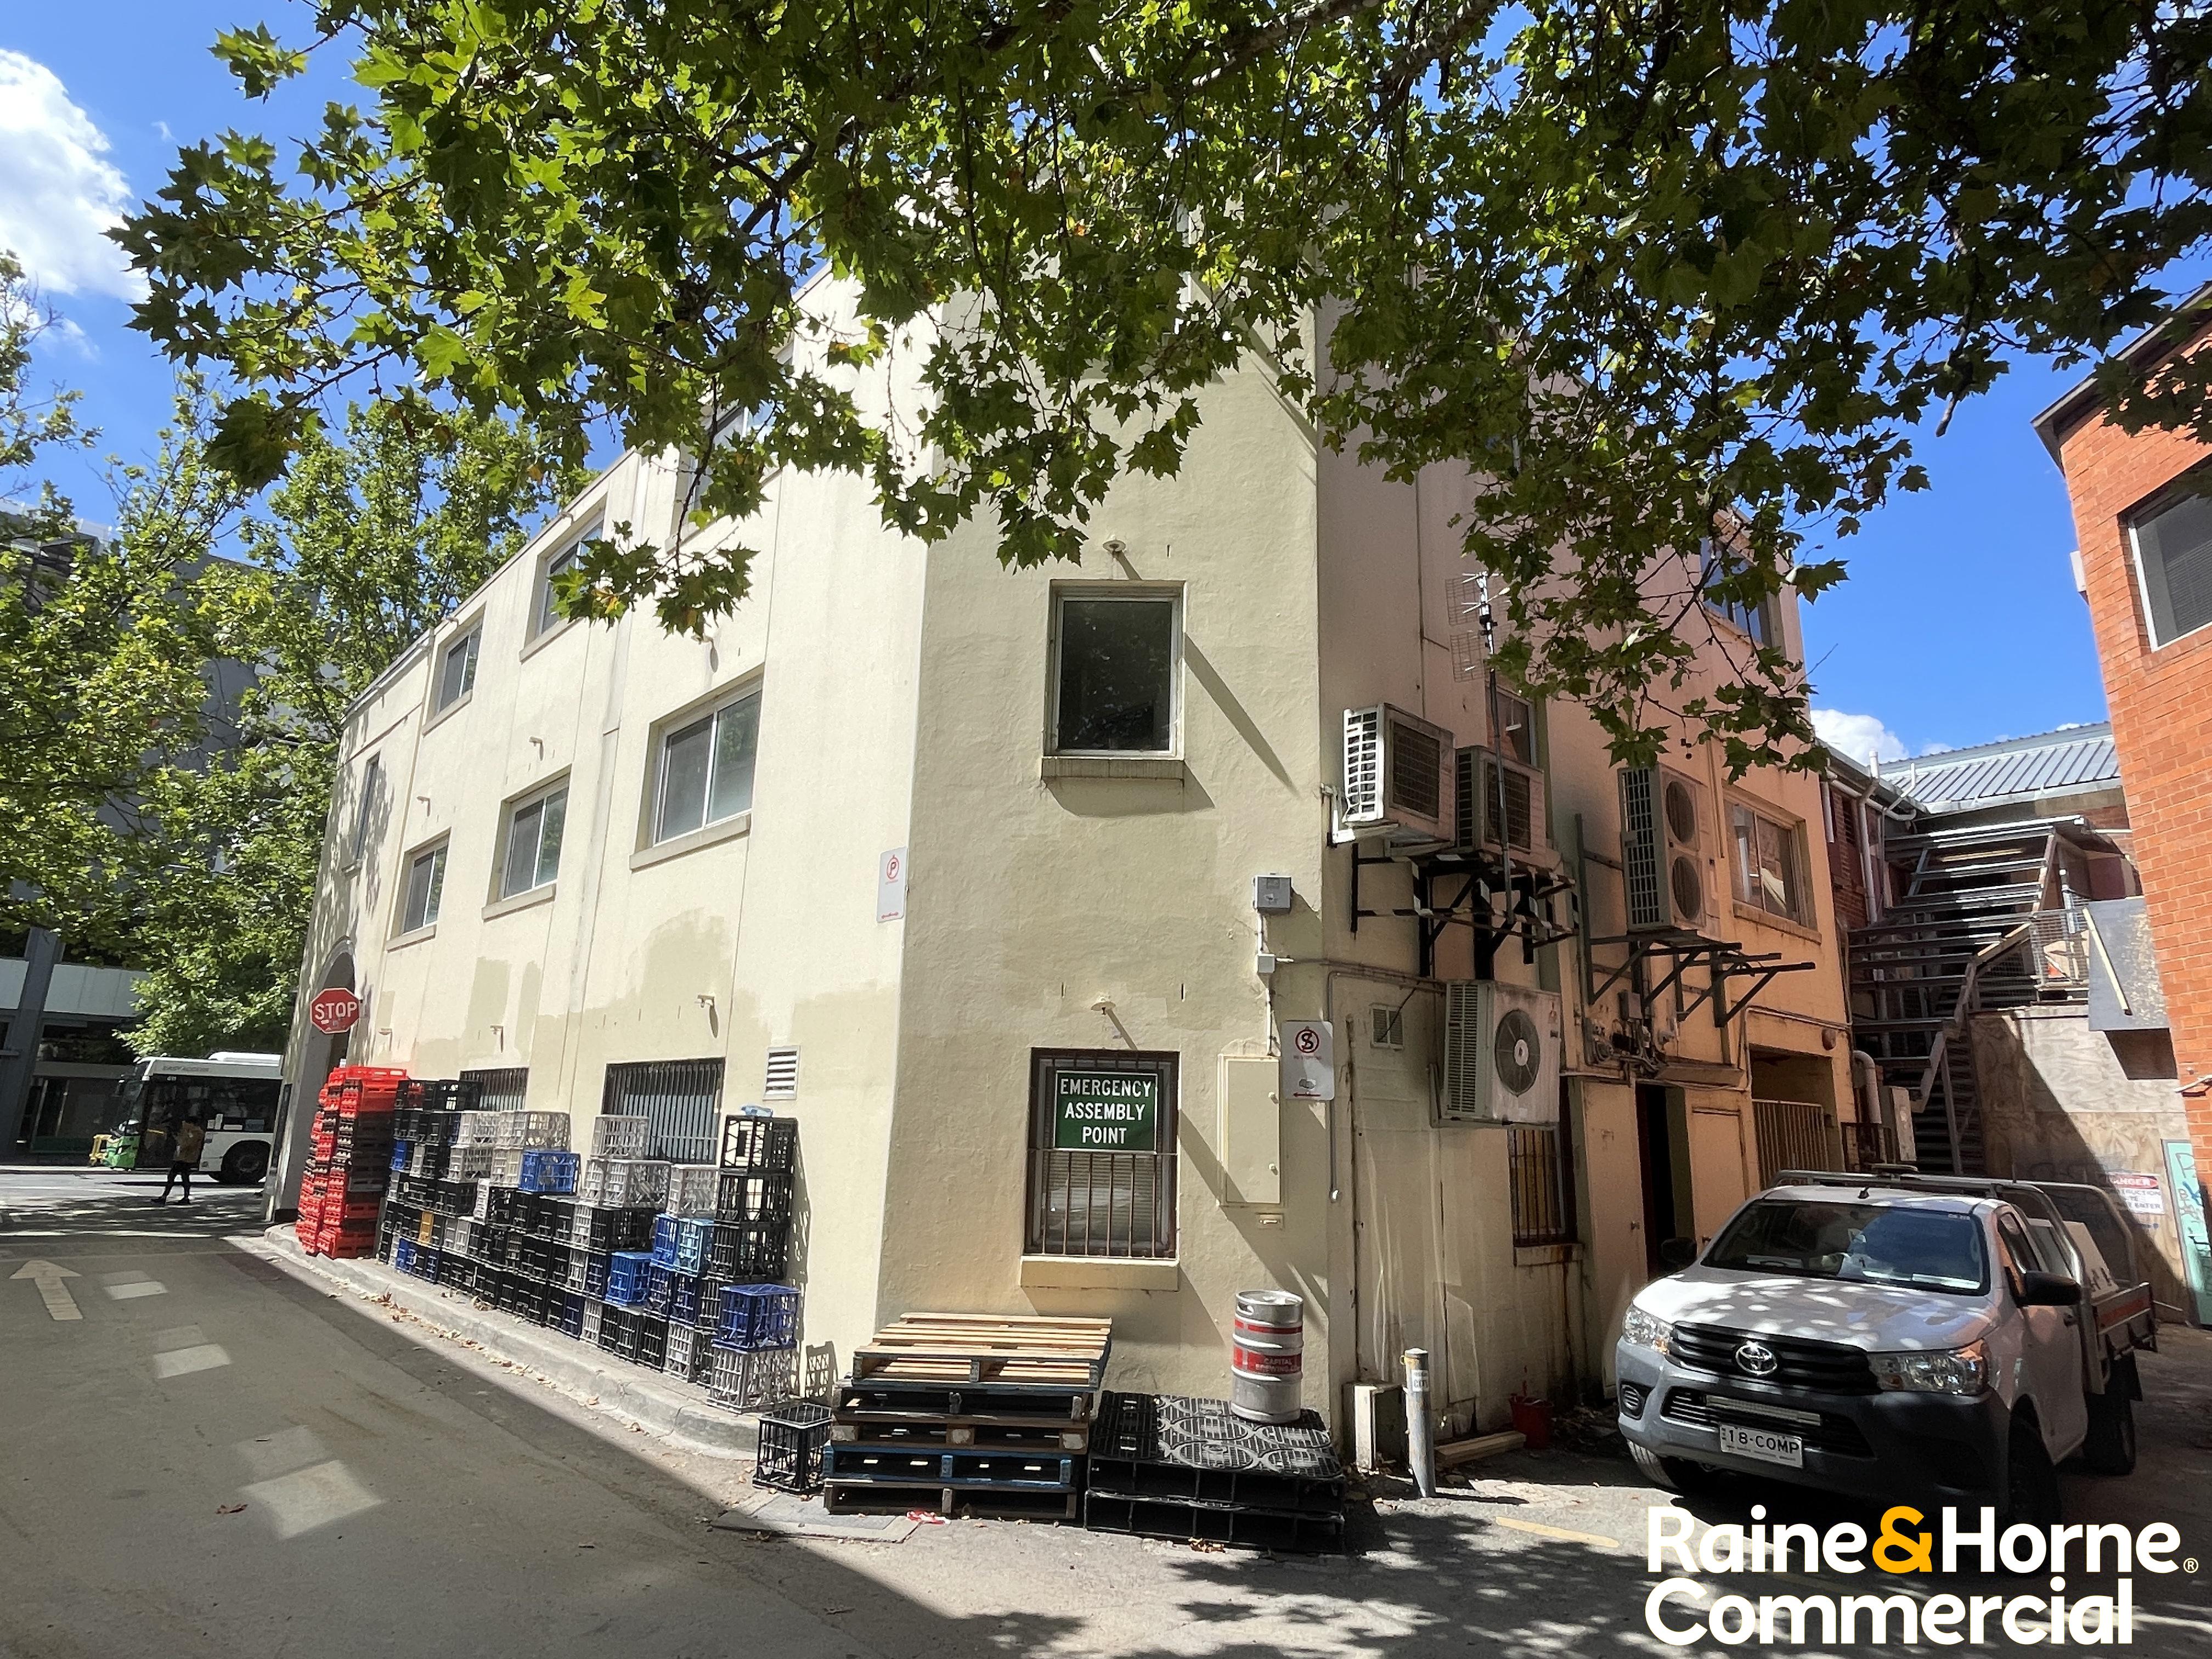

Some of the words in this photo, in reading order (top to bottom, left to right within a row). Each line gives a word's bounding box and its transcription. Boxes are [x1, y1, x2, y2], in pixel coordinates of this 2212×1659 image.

[314, 1002, 358, 1020] STOP
[1060, 1079, 1152, 1097] EMERGENCY
[1064, 1102, 1146, 1120] ASSEMBLY
[1082, 1126, 1127, 1144] POINT
